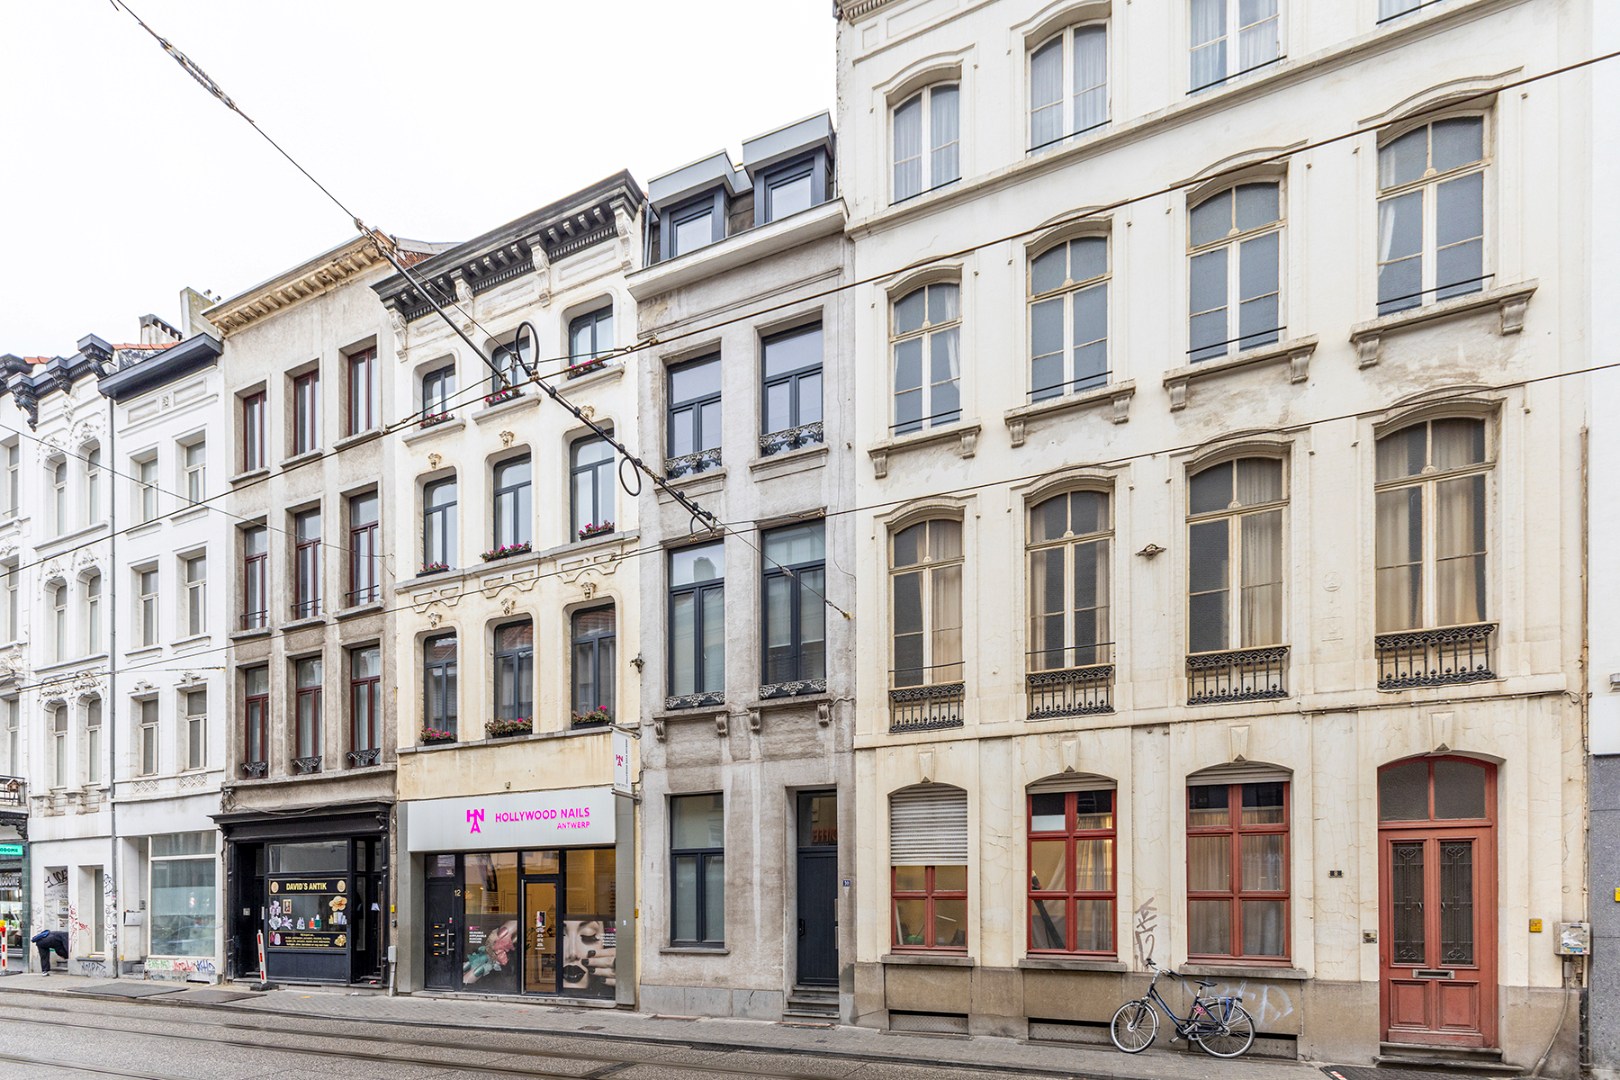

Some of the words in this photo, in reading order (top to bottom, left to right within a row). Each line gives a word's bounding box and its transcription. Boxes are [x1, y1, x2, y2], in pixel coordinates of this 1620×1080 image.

[495, 809, 557, 823] HOLLYWOOD
[560, 807, 590, 818] NAILS
[557, 821, 590, 830] ANTWERP
[286, 882, 308, 891] DAVID'S
[309, 882, 327, 890] ANTIK
[454, 889, 461, 897] 12
